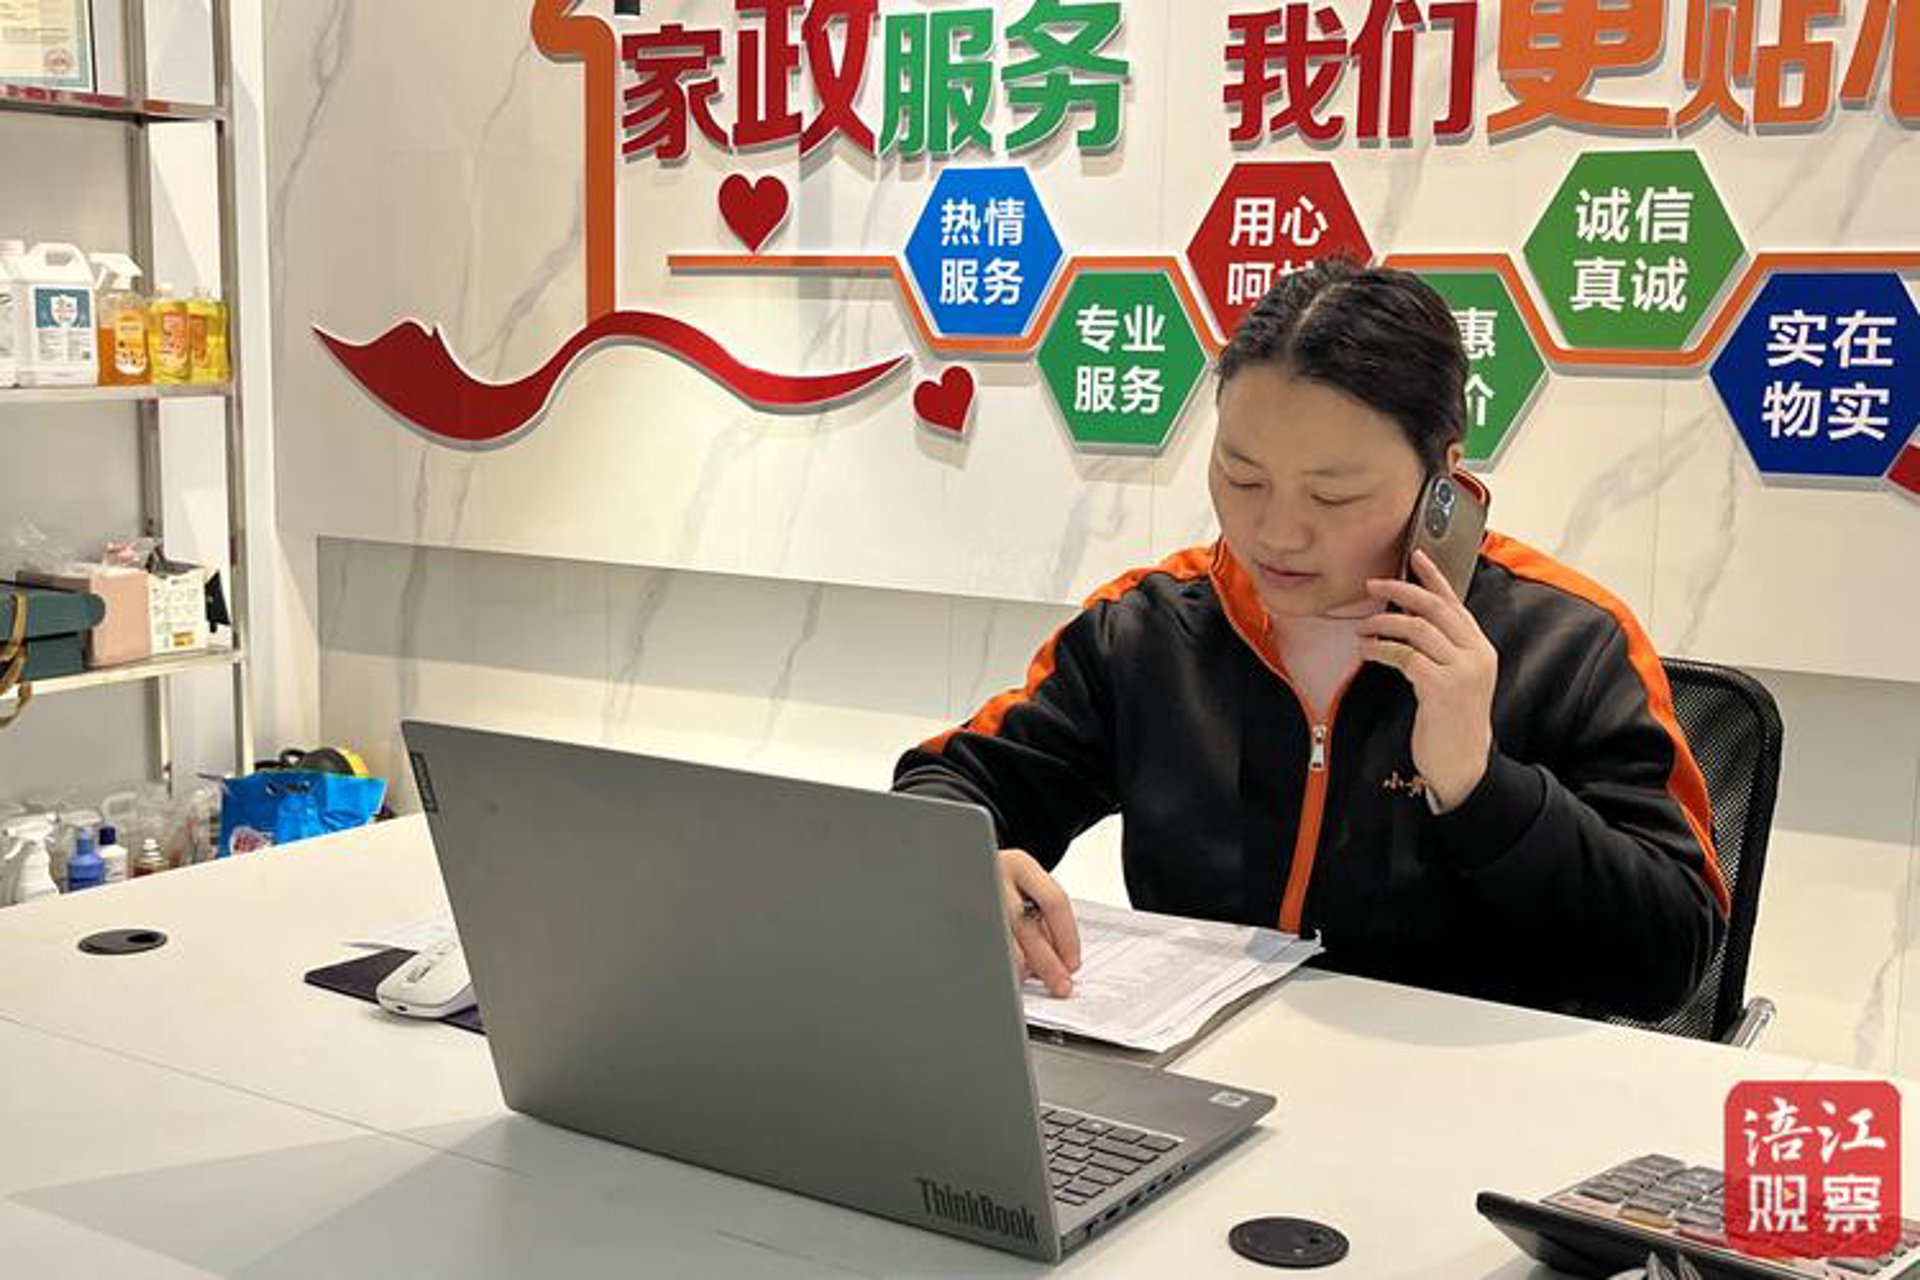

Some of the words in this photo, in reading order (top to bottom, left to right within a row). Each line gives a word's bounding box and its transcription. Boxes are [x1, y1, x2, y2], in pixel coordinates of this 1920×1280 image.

[621, 0, 1129, 159] 家政服务
[940, 198, 1024, 246] 热情
[1229, 196, 1328, 247] 用心
[1575, 186, 1693, 244] 诚信
[939, 260, 1024, 306] 服务
[1228, 260, 1315, 307] 呵
[1570, 257, 1688, 313] 真诚
[1075, 304, 1166, 353] 专业
[1450, 307, 1498, 359] 惠
[1767, 310, 1897, 368] 实在
[1075, 366, 1164, 415] 服务
[1762, 382, 1890, 441] 物实
[914, 1178, 1039, 1243] ThinkBook
